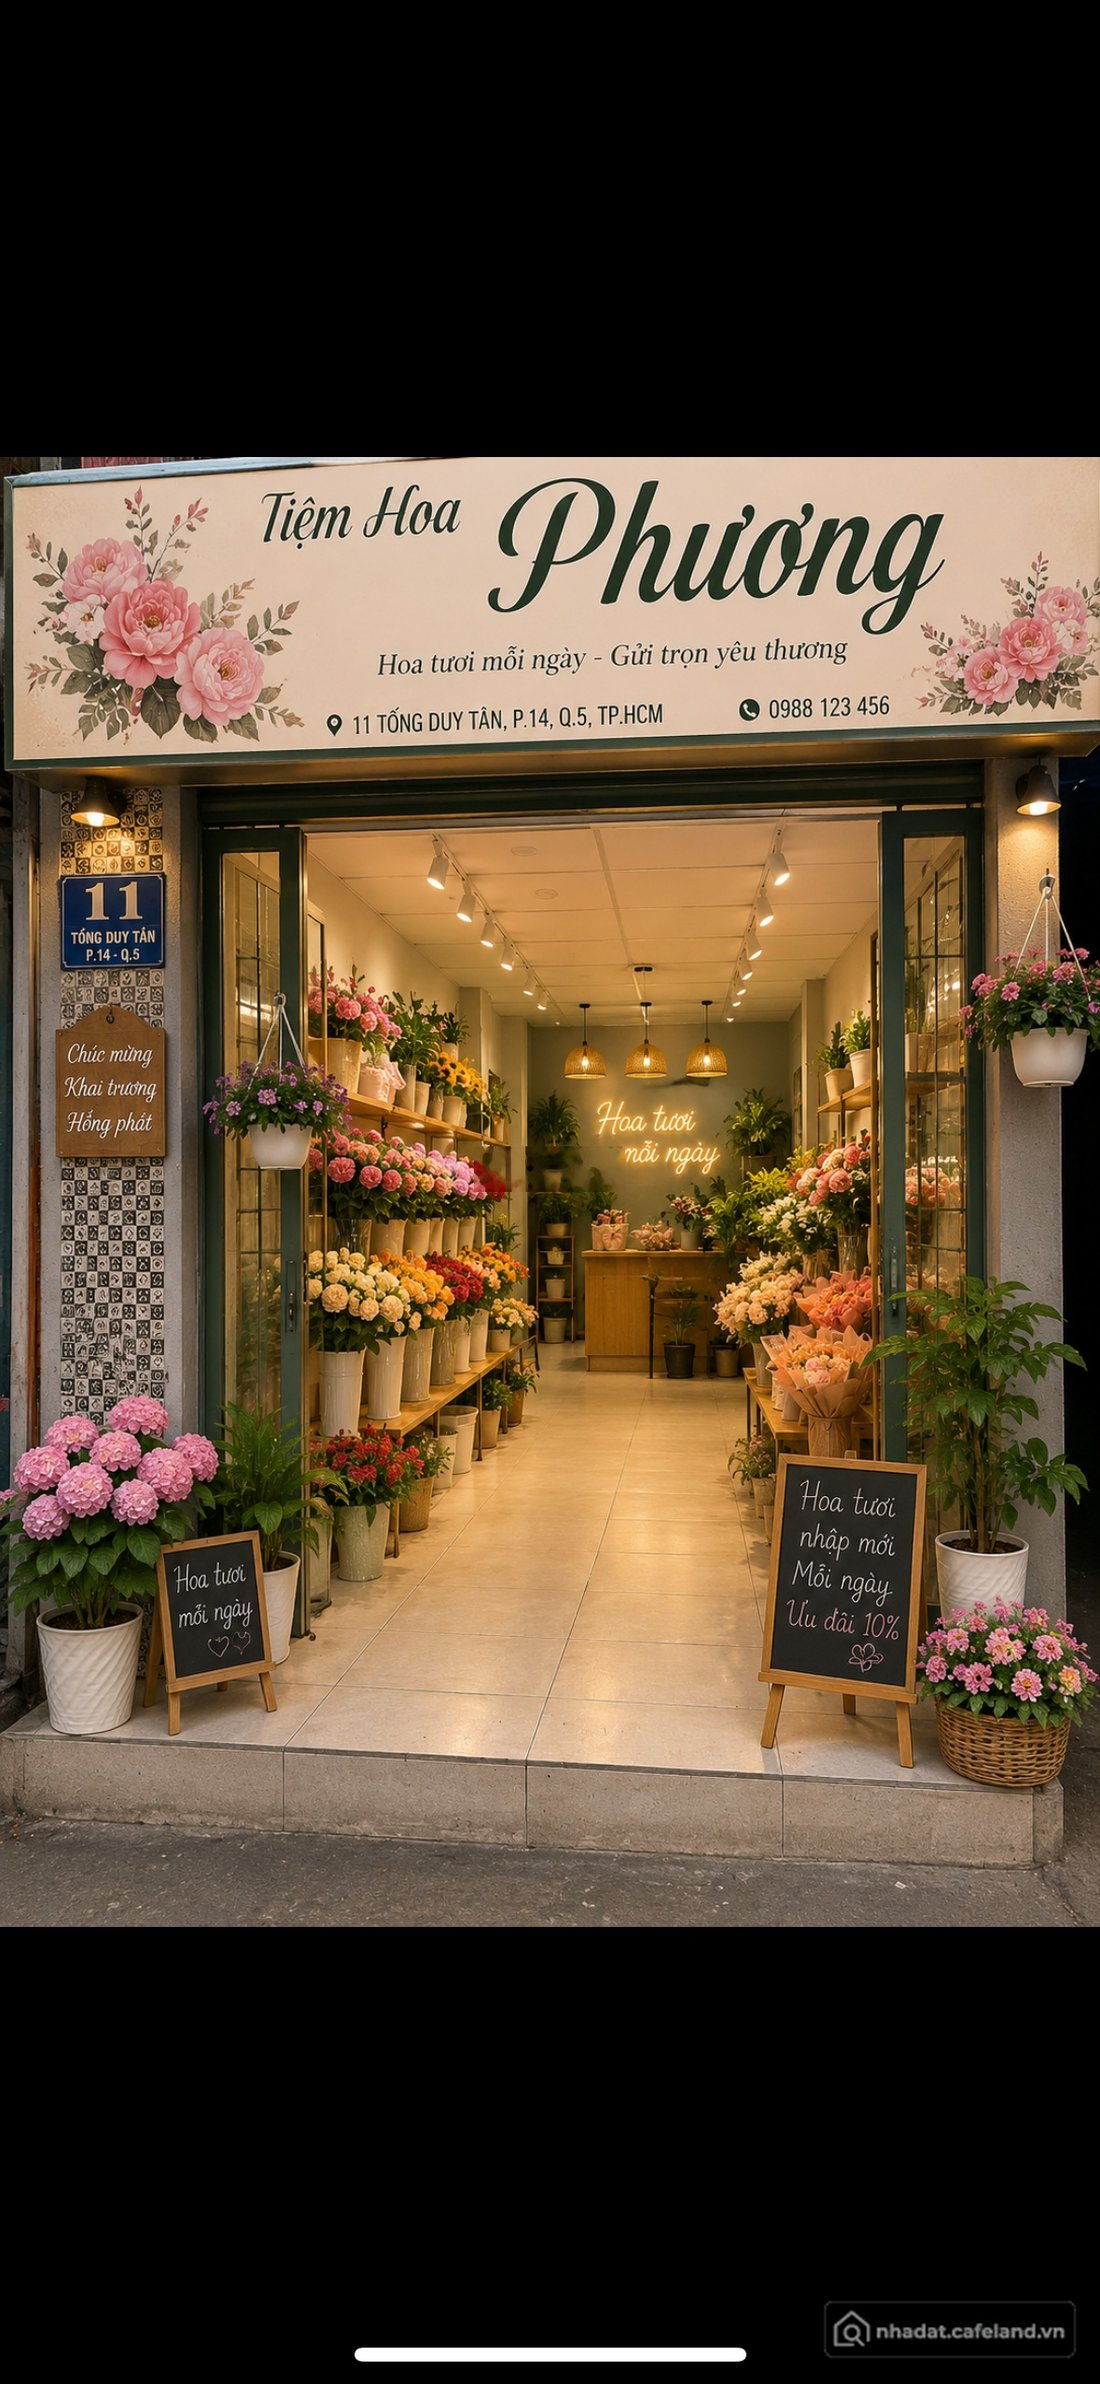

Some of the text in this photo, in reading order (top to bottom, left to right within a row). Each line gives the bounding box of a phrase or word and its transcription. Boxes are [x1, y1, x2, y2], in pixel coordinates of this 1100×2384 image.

[261, 477, 945, 636] Tiệm Hoa Phương
[377, 653, 423, 675] Hoa
[431, 651, 475, 673] tươi
[482, 645, 525, 671] mỗi
[531, 647, 586, 676] ngày
[611, 642, 652, 666] Gửi
[661, 647, 708, 669] trọn
[714, 641, 756, 669] yêu
[765, 638, 848, 665] thương
[353, 704, 663, 735] 11 TỐNG DUY TÂN, P.14, Q.5, TP.HCM
[769, 695, 890, 718] 0988 123 456
[85, 881, 143, 920] 11
[106, 930, 130, 944] DUY
[86, 948, 111, 961] P.14
[121, 948, 140, 963] Q.5
[67, 1043, 153, 1069] Chúc mừng
[64, 1076, 157, 1103] Khai trương
[596, 1100, 696, 1136] Hoa tươi
[664, 1142, 721, 1175] ngày
[799, 1479, 897, 1519] Hoa tươi
[800, 1523, 896, 1561] nhập mới
[173, 1561, 247, 1594] Hoa tươi
[840, 1572, 894, 1608] ngày
[214, 1598, 254, 1630] ngày
[786, 1599, 817, 1629] Ưu
[862, 1612, 901, 1641] 10%
